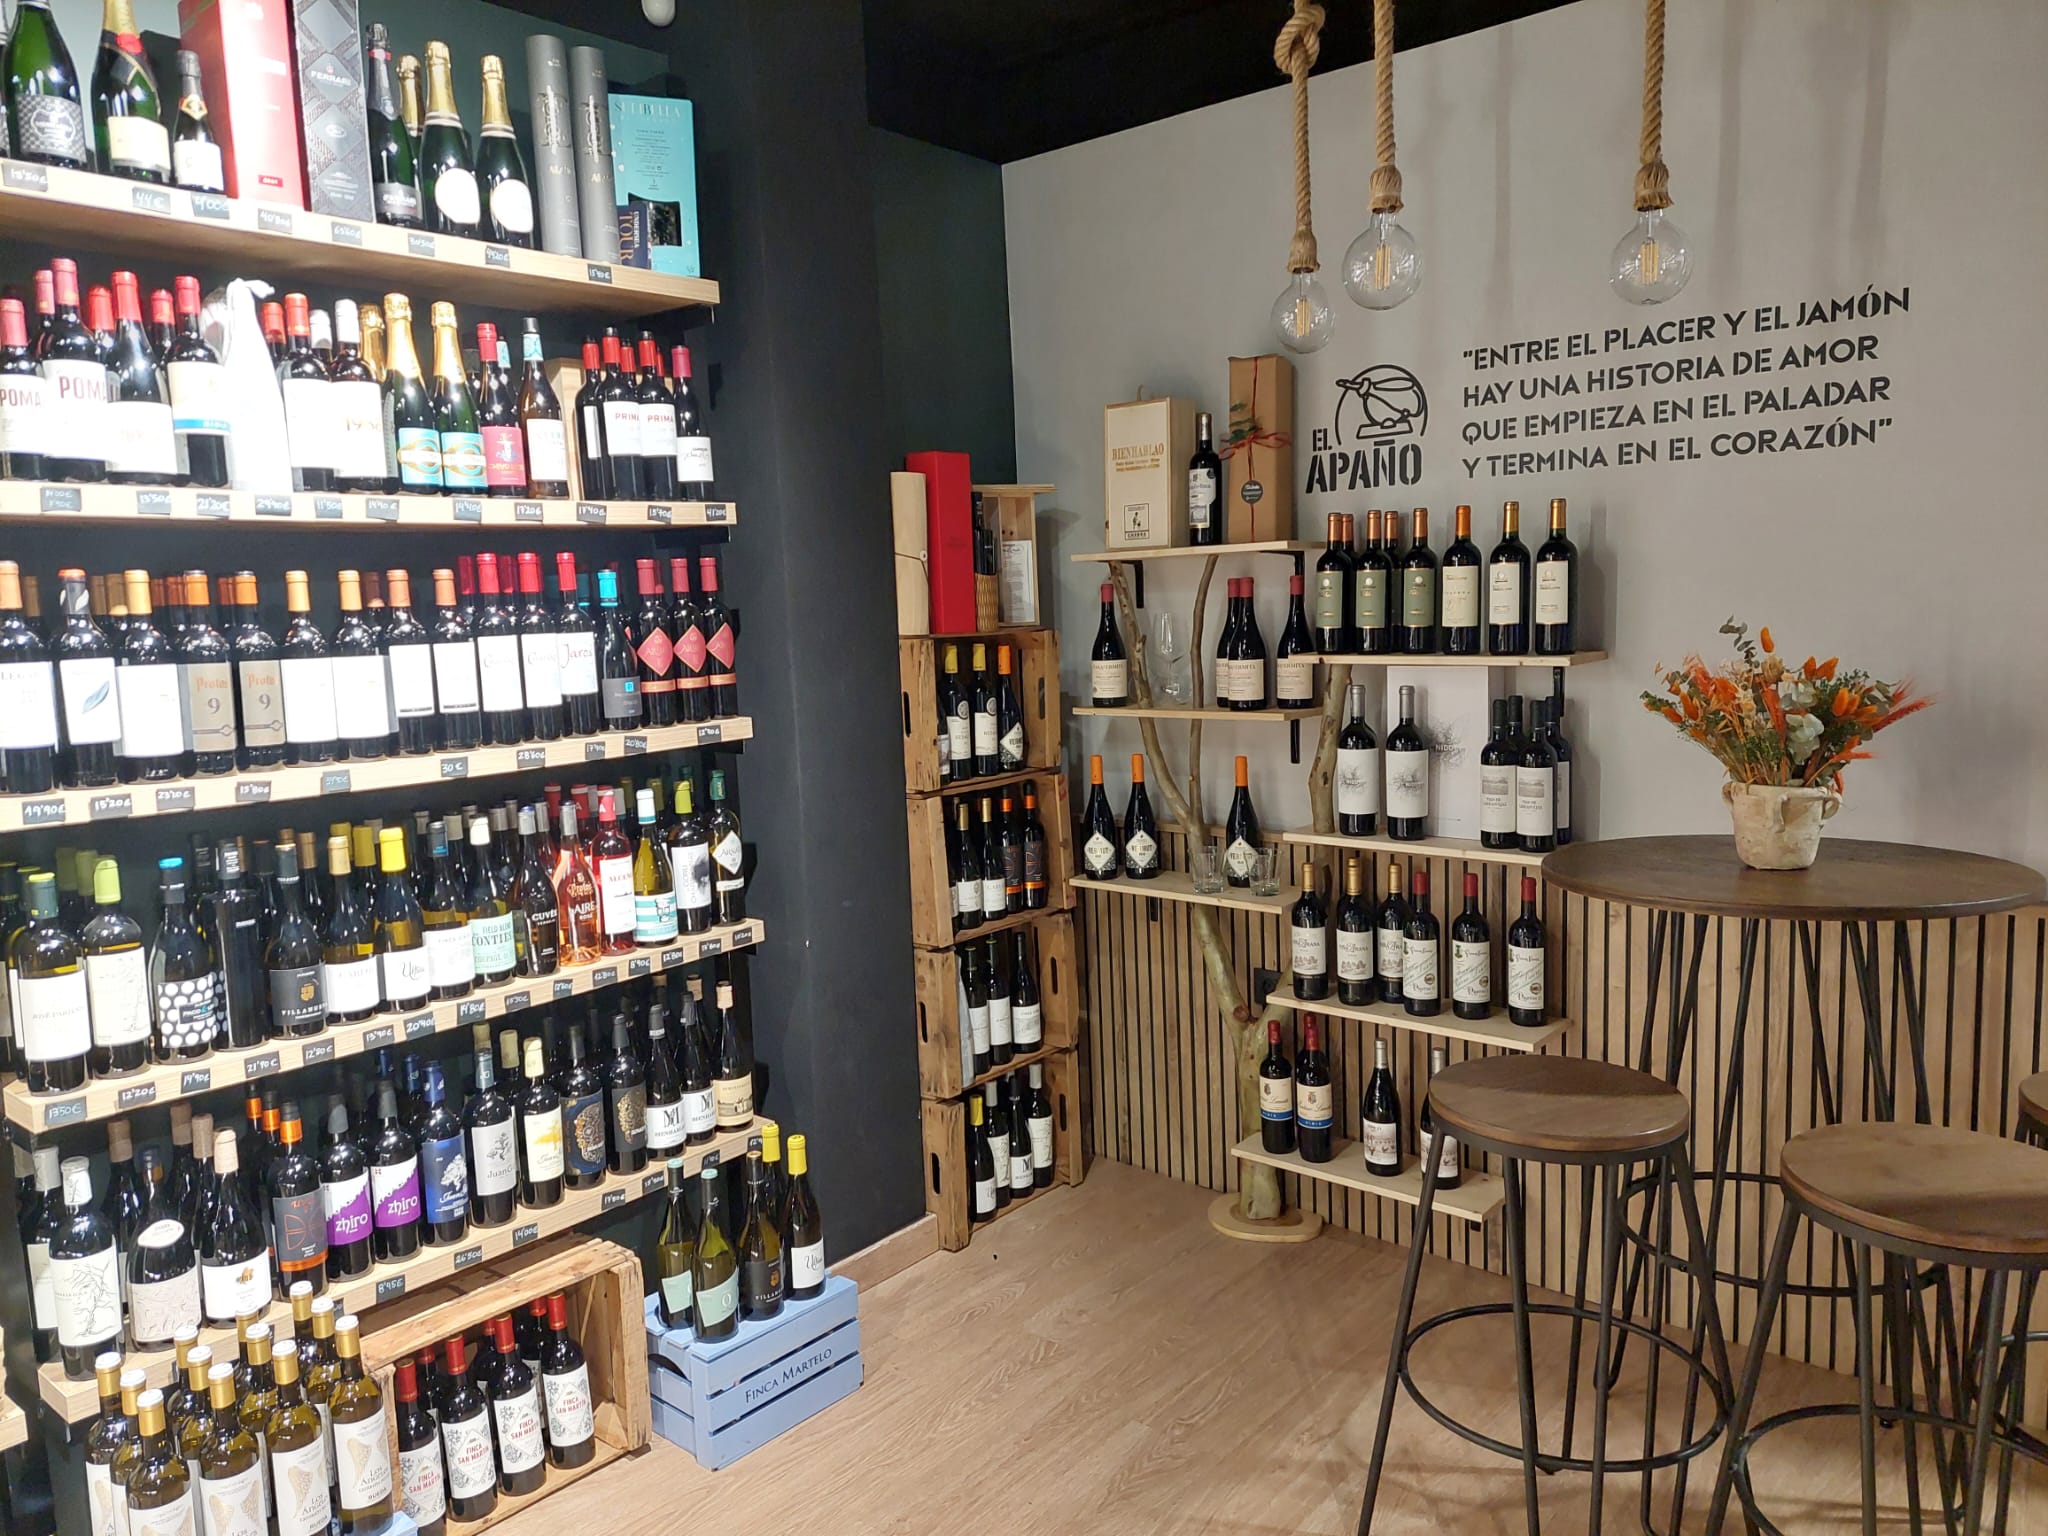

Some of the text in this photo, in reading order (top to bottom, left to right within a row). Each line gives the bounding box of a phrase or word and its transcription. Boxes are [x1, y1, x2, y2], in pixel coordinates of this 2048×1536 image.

[618, 212, 634, 260] TOUR
[1567, 334, 1597, 359] EL
[1605, 315, 1716, 354] PLACER
[1724, 312, 1748, 336] Y
[1754, 306, 1791, 332] EL
[1796, 284, 1911, 328] JAMÓN
[1463, 335, 1880, 409] HAY UNA HISTORIA DE AMOR
[1462, 376, 1892, 445] QUE EMPIEZA EN EL PALADAR
[1312, 428, 1333, 451] EL
[1462, 457, 1485, 480] Y
[1486, 446, 1609, 477] TERMINA
[1618, 441, 1658, 467] EN
[1668, 436, 1702, 462] EL
[1305, 439, 1422, 494] APAÑO
[207, 698, 221, 715] 9
[258, 694, 272, 711] 9
[335, 1213, 368, 1235] zhiro
[388, 1195, 418, 1216] zhiro
[744, 1348, 833, 1404] FINCA MARTELO
